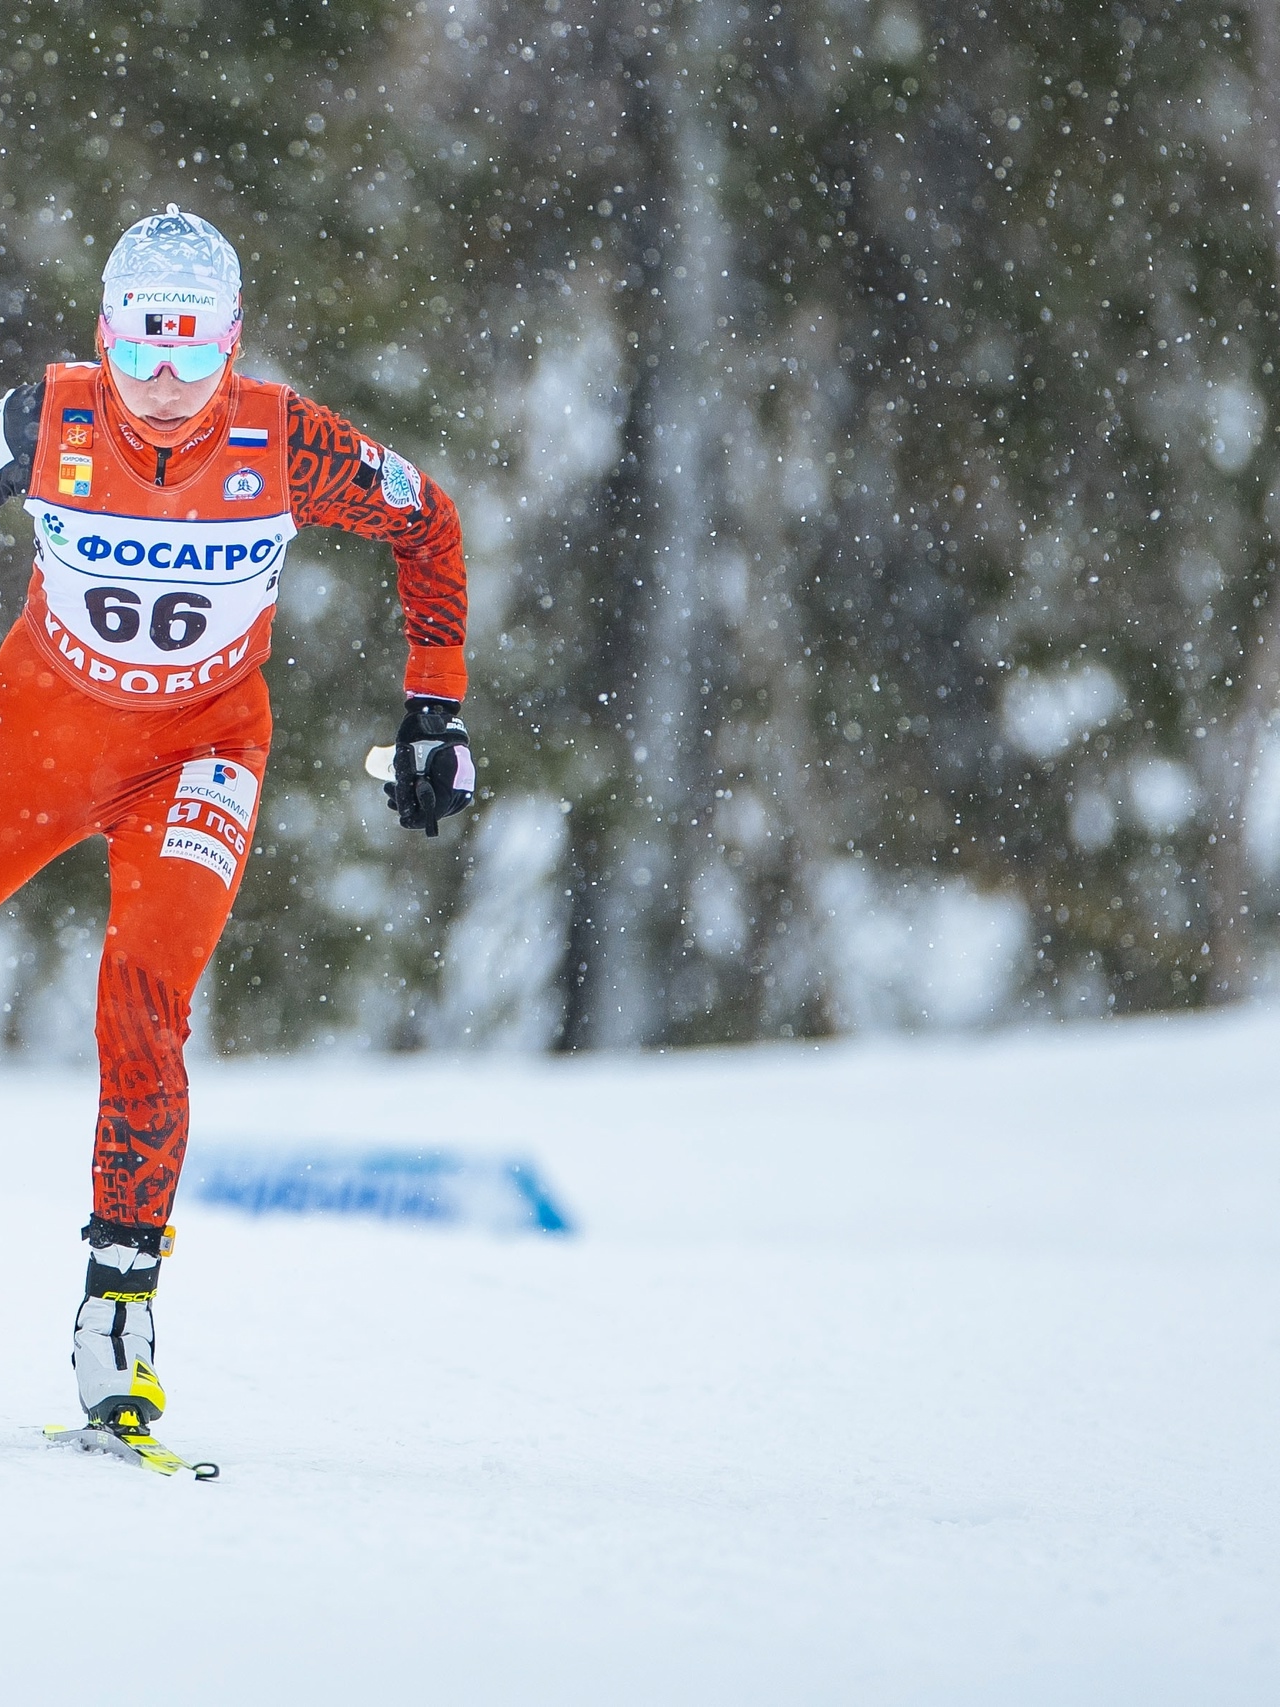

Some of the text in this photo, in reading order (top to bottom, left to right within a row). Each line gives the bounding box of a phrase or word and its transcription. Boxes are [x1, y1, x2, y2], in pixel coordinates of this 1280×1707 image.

[136, 292, 216, 307] РУСКЛИМАТ
[77, 535, 275, 571] ФОСАГРО
[84, 587, 212, 652] 66
[180, 785, 249, 822] РУСКЛИМАТ
[205, 810, 246, 856] ПСБ
